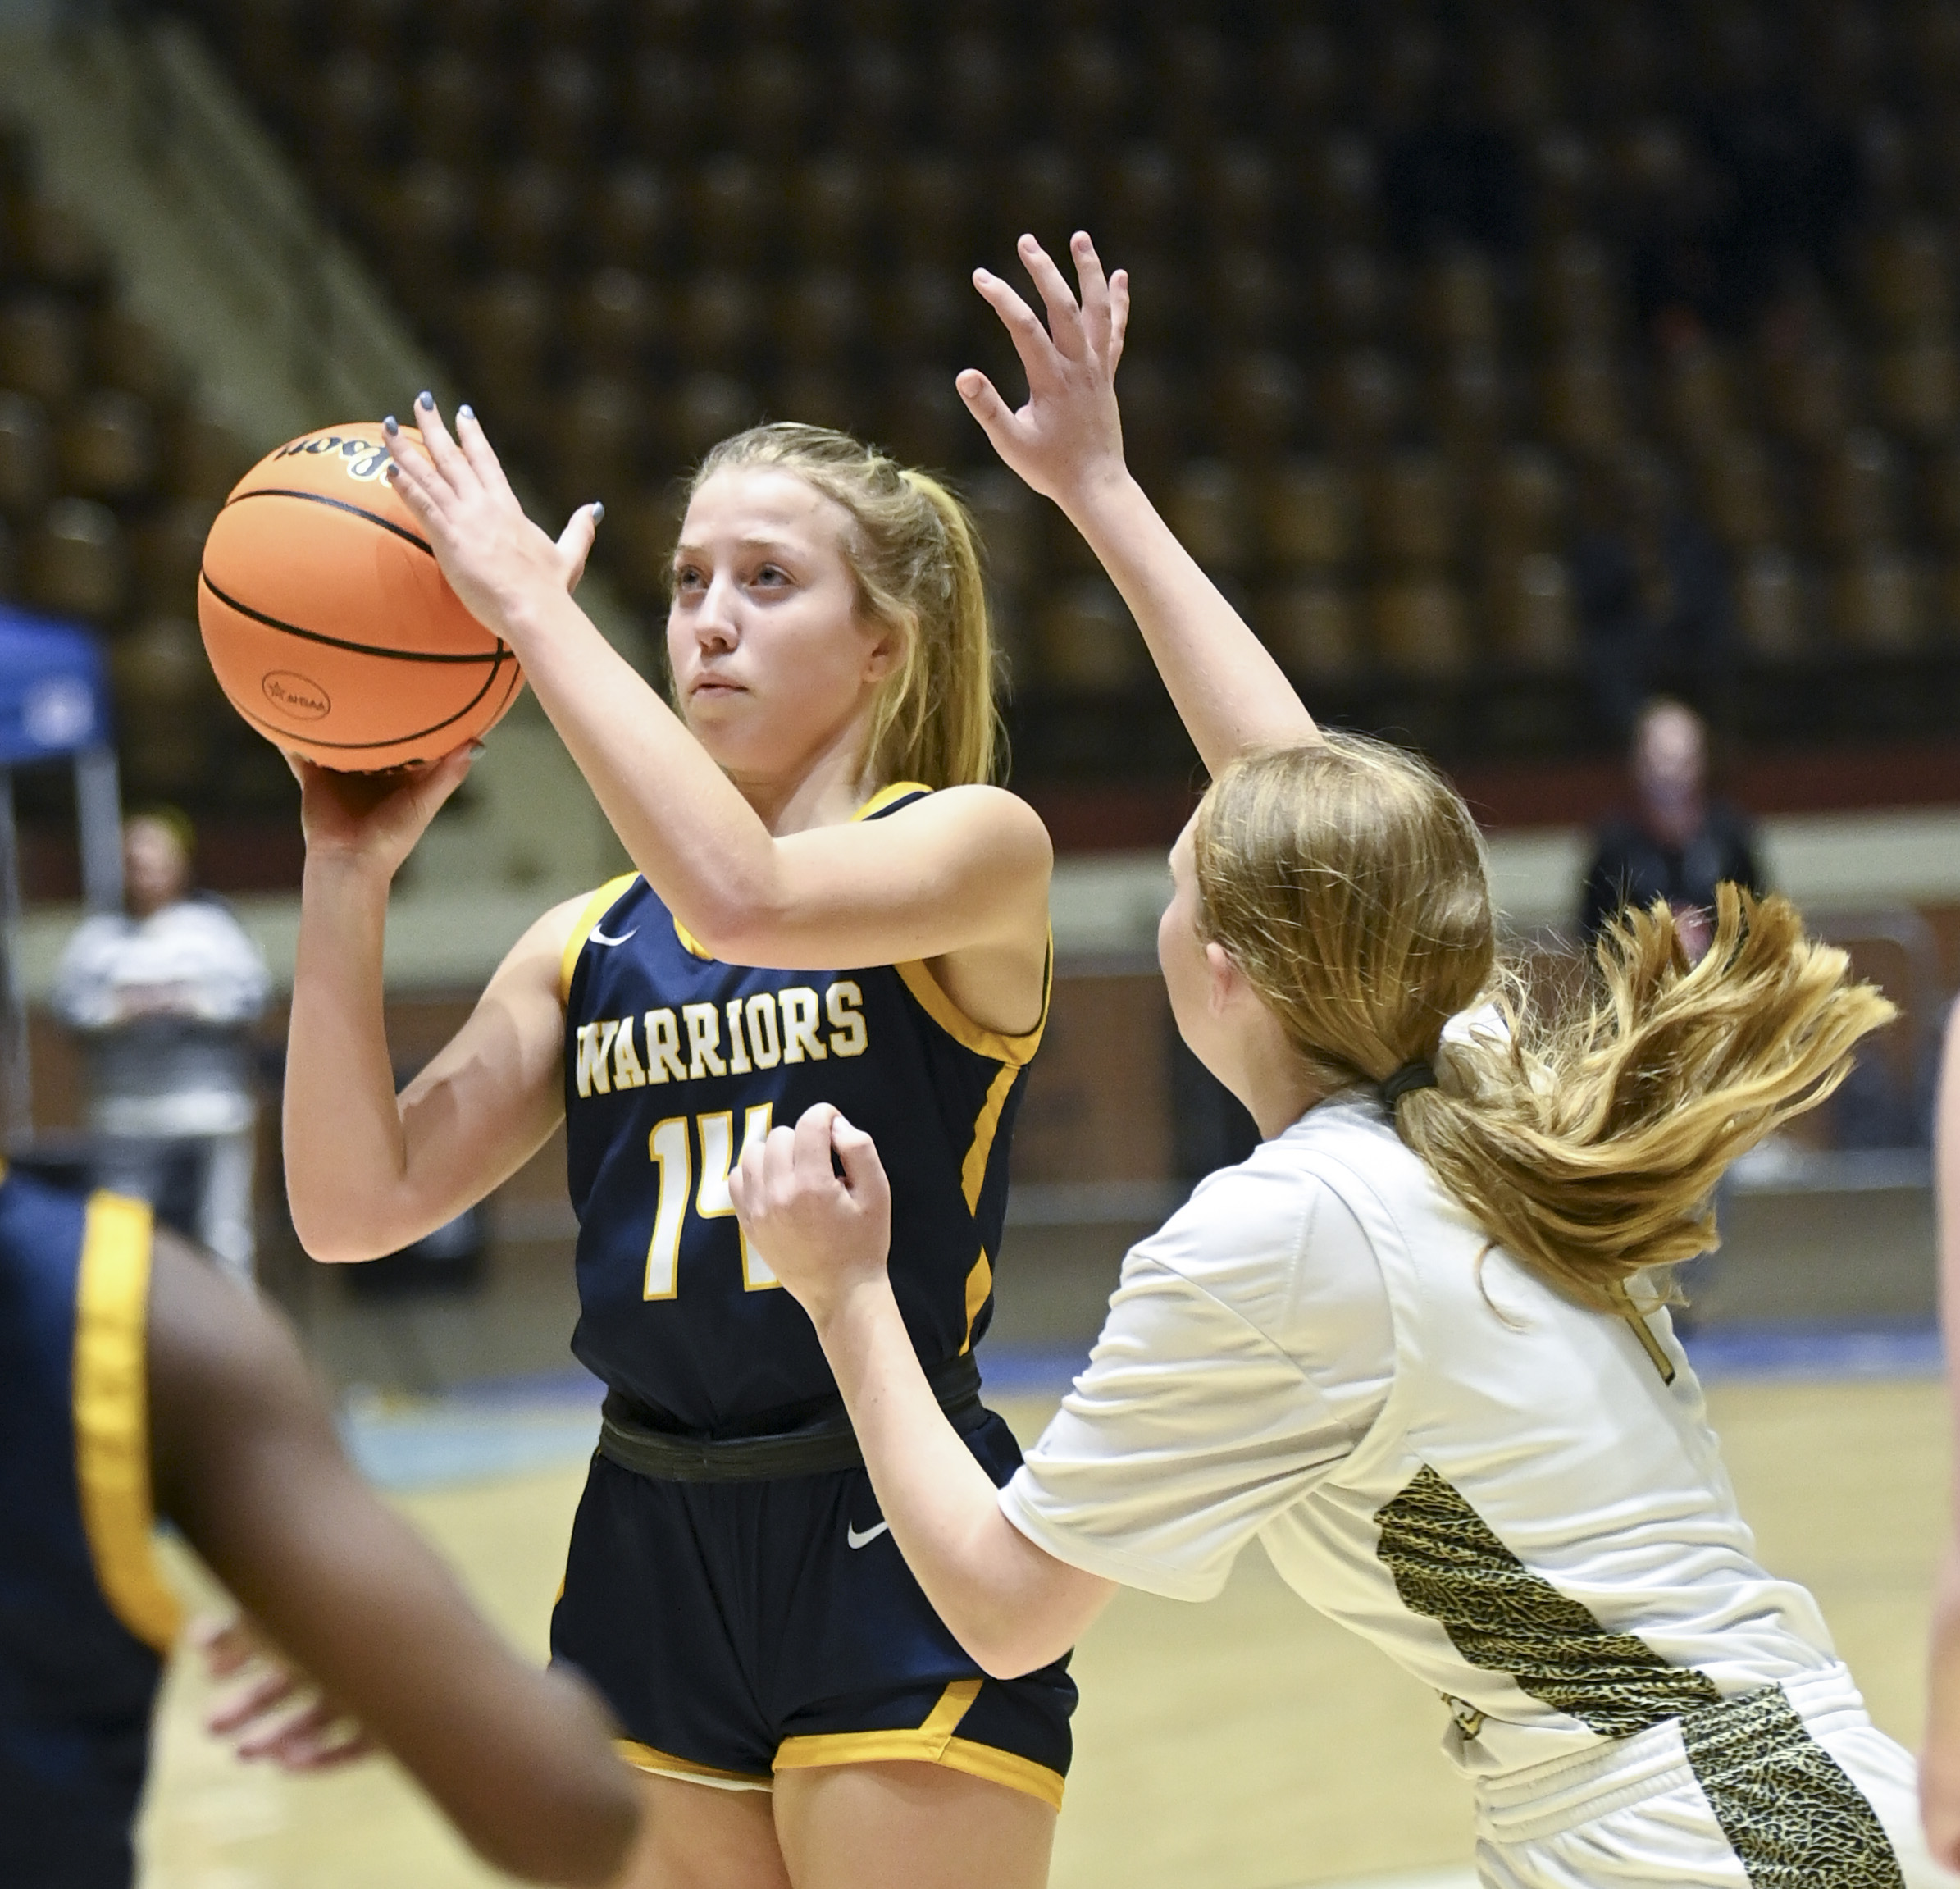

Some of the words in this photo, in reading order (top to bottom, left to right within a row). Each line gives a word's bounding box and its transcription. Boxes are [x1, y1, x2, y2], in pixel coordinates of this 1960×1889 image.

[273, 436, 393, 489] lson
[577, 980, 868, 1098] WARRIORS
[643, 1102, 784, 1302] 14
